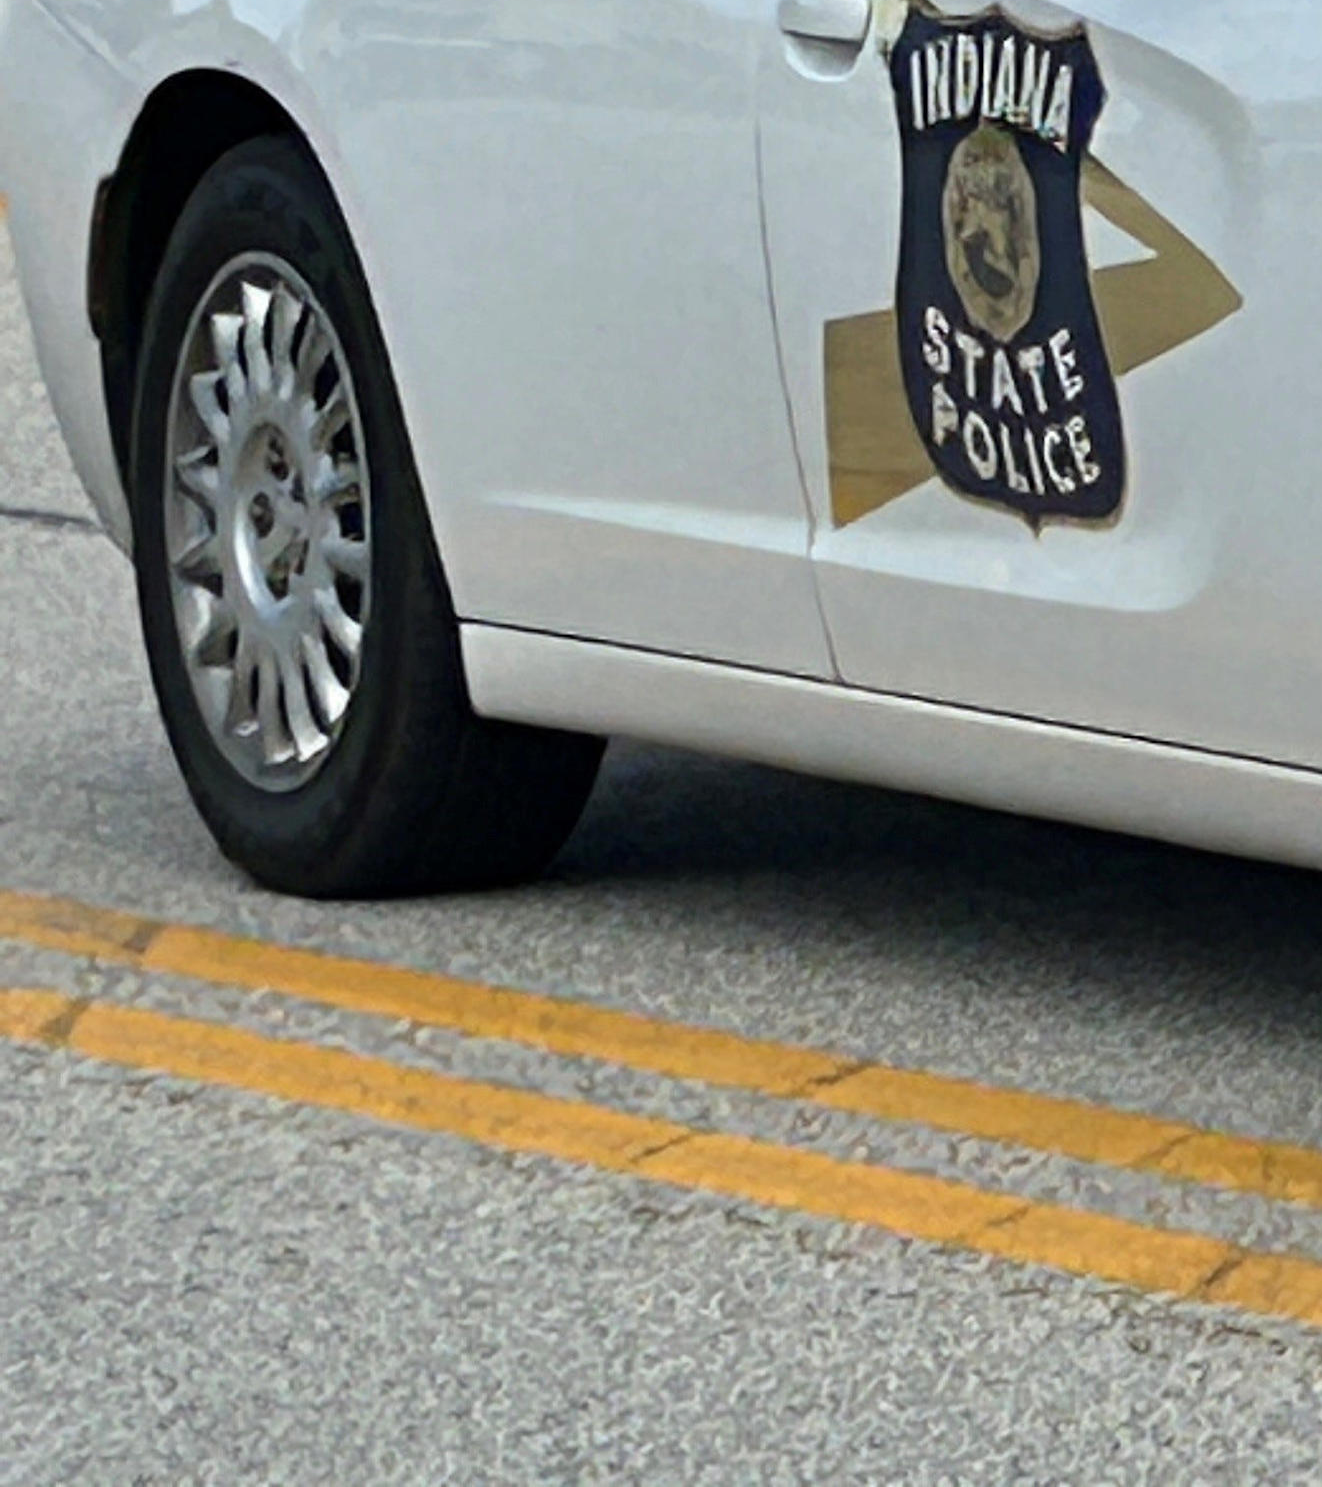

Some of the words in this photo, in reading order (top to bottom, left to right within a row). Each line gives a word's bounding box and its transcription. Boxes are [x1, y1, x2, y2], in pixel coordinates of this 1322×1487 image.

[909, 32, 1074, 154] INDIANA
[922, 305, 1084, 416] STATE
[930, 381, 1101, 498] POLICE
